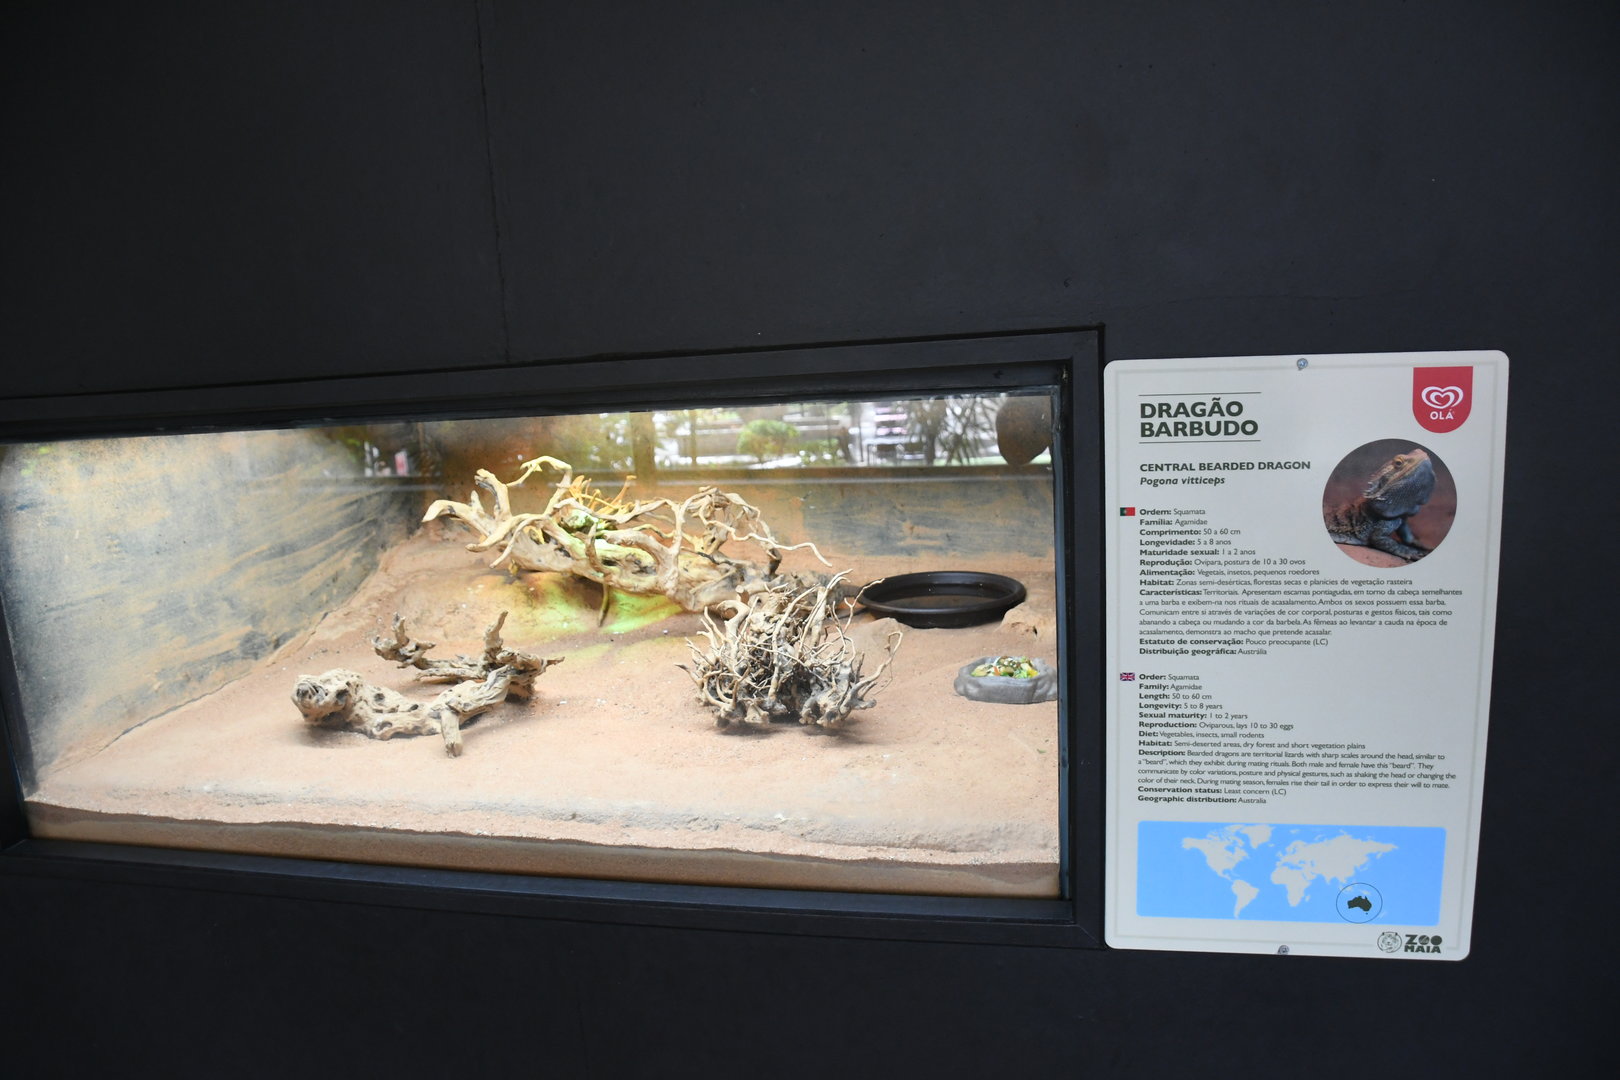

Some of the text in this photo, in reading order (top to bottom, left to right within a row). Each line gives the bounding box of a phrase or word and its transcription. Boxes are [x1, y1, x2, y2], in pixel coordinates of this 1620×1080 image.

[1140, 396, 1243, 418] DRAGÃO
[1430, 409, 1454, 420] OLÁ
[1140, 419, 1258, 437] BARBUDO
[1139, 461, 1310, 472] CENTRAL BEARDED DRAGON
[1140, 475, 1225, 487] Pogona vitticeps
[1174, 518, 1207, 526] Agamidae
[1139, 528, 1201, 536] Comprimento:
[1139, 539, 1195, 547] Longevidade:
[1405, 934, 1442, 946] ZOO
[1404, 945, 1441, 954] MAIA
